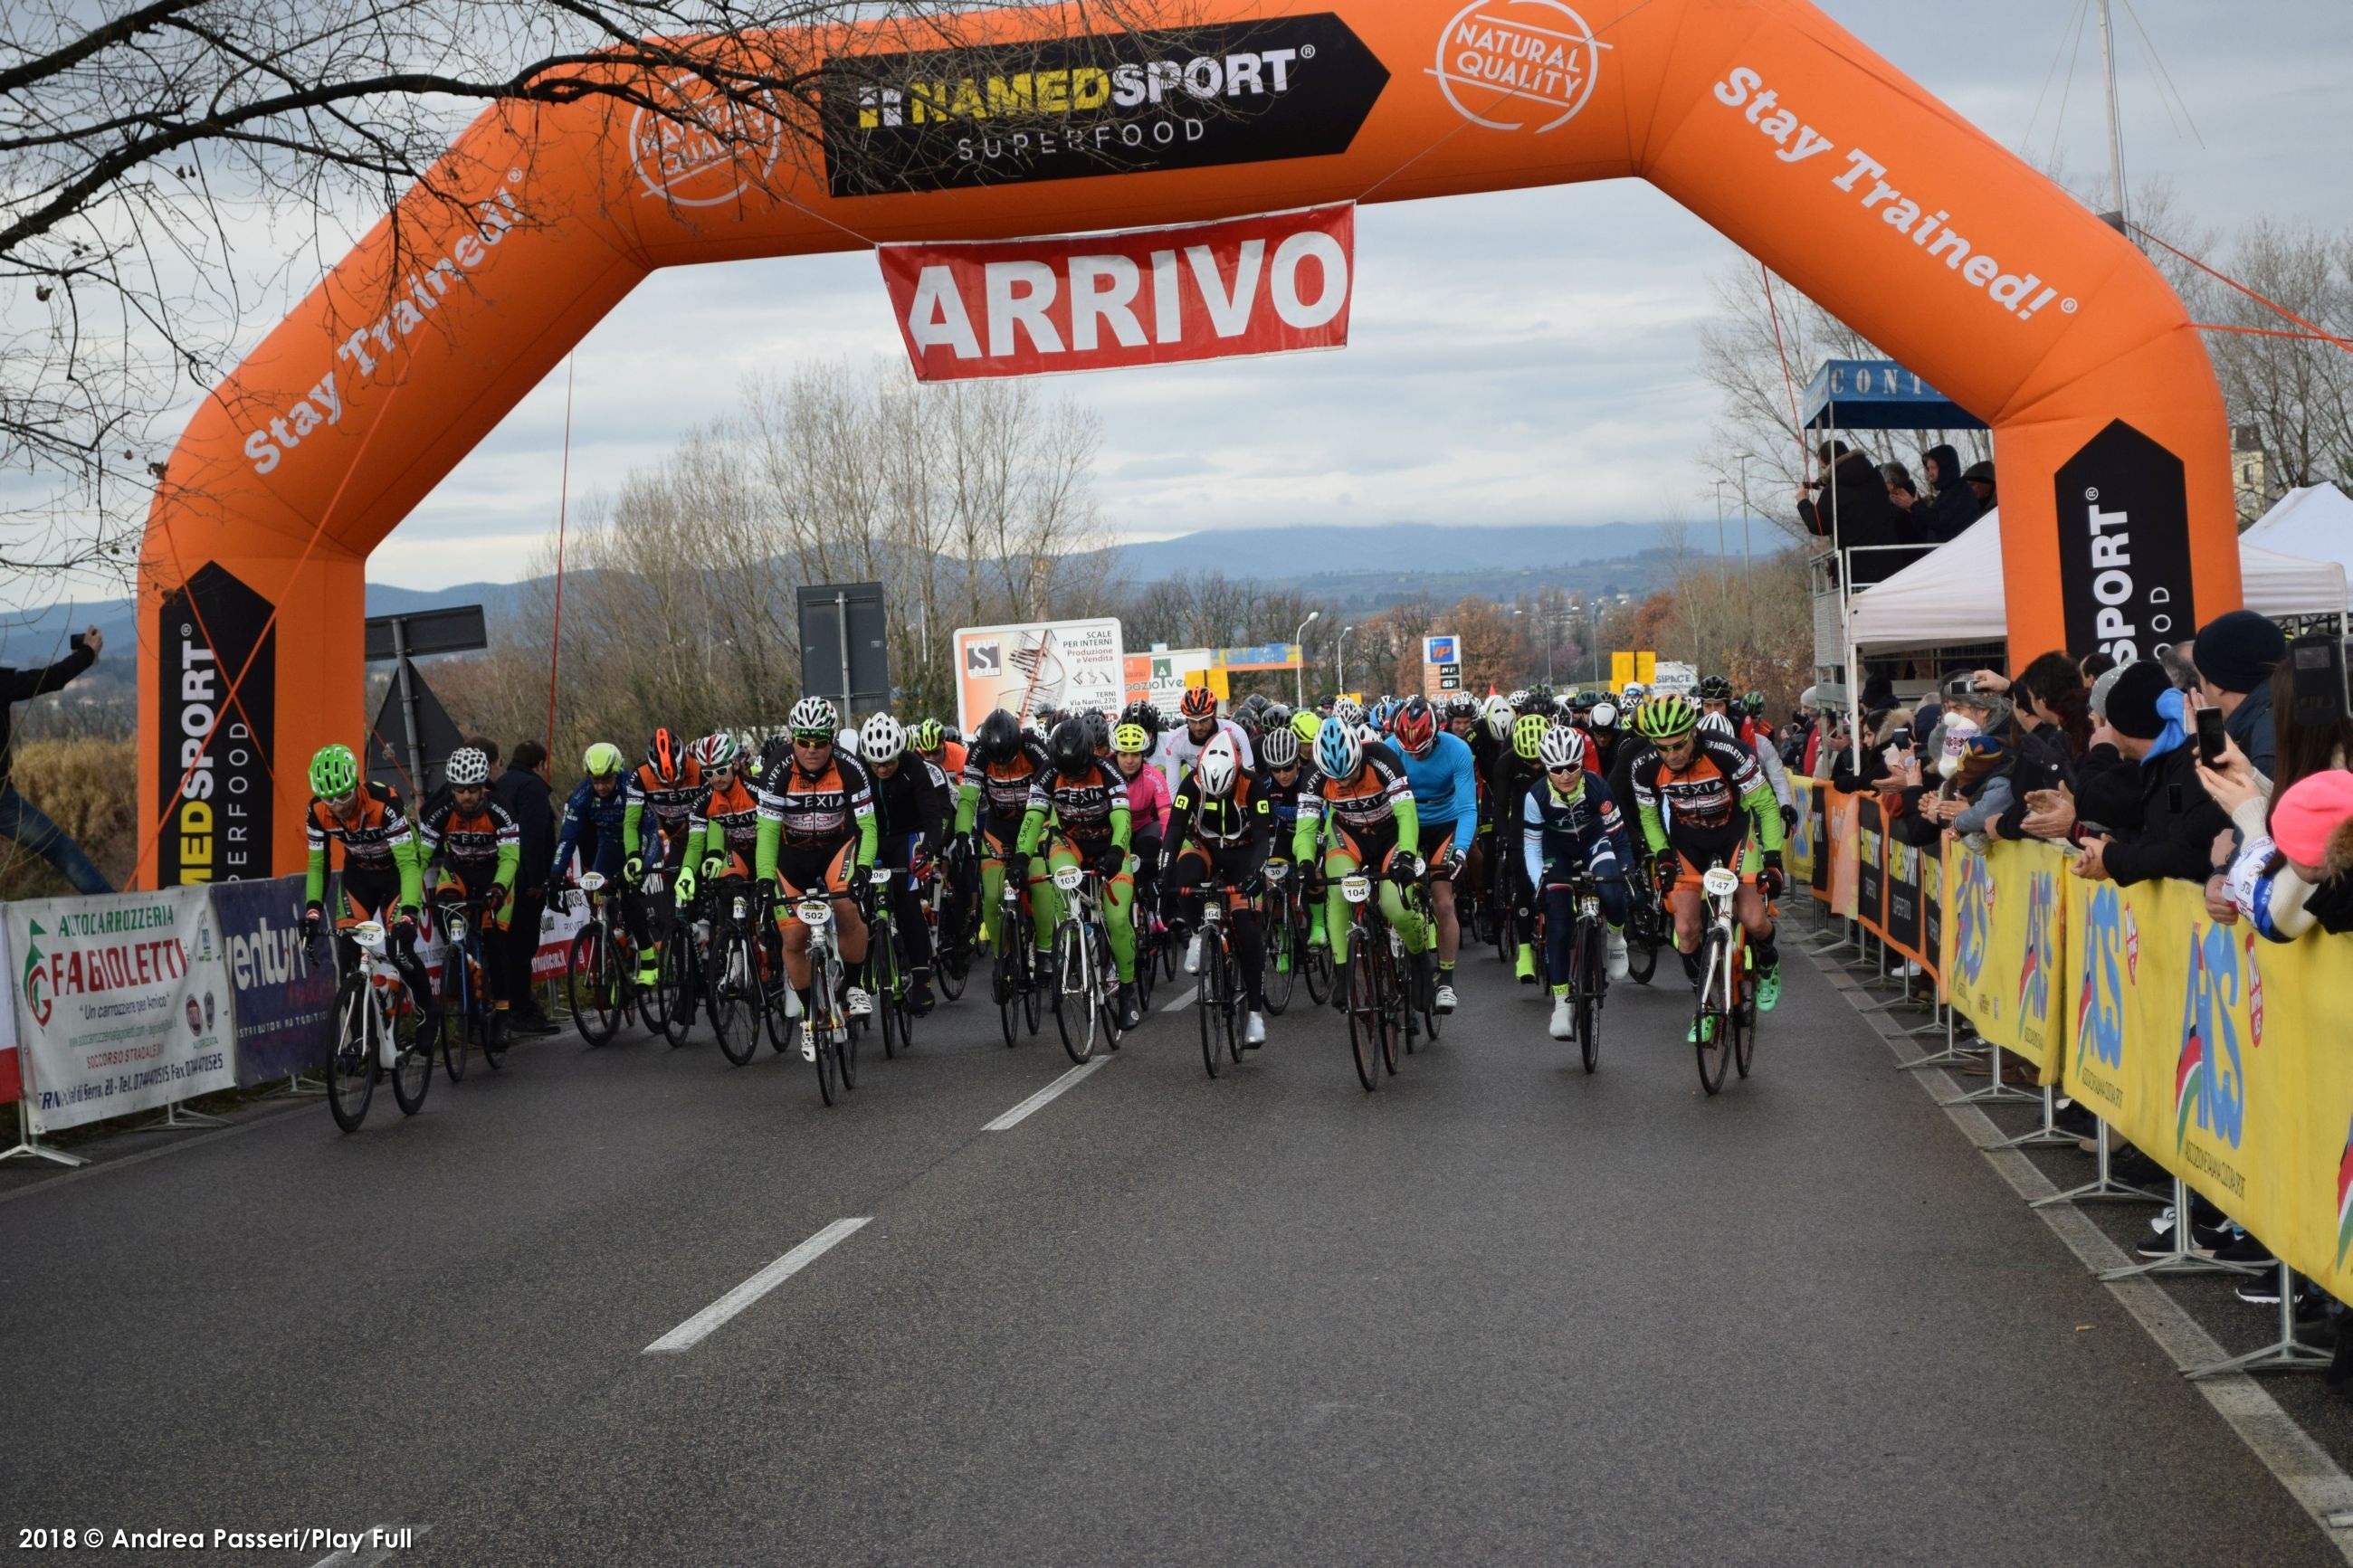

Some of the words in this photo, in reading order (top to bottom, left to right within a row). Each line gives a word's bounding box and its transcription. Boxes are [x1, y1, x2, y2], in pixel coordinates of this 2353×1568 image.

[1455, 23, 1582, 72] NATURAL
[1457, 50, 1583, 100] QUALITY
[1713, 66, 1834, 164] Stay
[958, 119, 1205, 160] SUPERFOOD
[908, 231, 1349, 360] ARRIVO
[1830, 368, 1942, 395] CONT
[244, 370, 342, 475] Stay
[1062, 640, 1080, 648] PER
[1080, 639, 1112, 647] INTERNI
[1086, 631, 1112, 639] SCALE
[1067, 649, 1113, 657] Produzione
[1083, 655, 1113, 663] Vendita
[1655, 674, 1691, 684] SIPACE
[1710, 740, 1746, 765] FAGIOLETTI
[842, 753, 869, 788] FAGIOLETTI
[1060, 876, 1077, 886] 103
[1710, 880, 1729, 890] 147
[1347, 888, 1366, 897] 104
[58, 905, 174, 937] AUTOCARROZZERIA
[361, 933, 375, 941] 92
[51, 937, 188, 997] FAGIOLETTI
[97, 1001, 137, 1020] carrozziere
[137, 1000, 148, 1016] per
[86, 1050, 124, 1069] SOCCORSO
[170, 1063, 186, 1080] Fax
